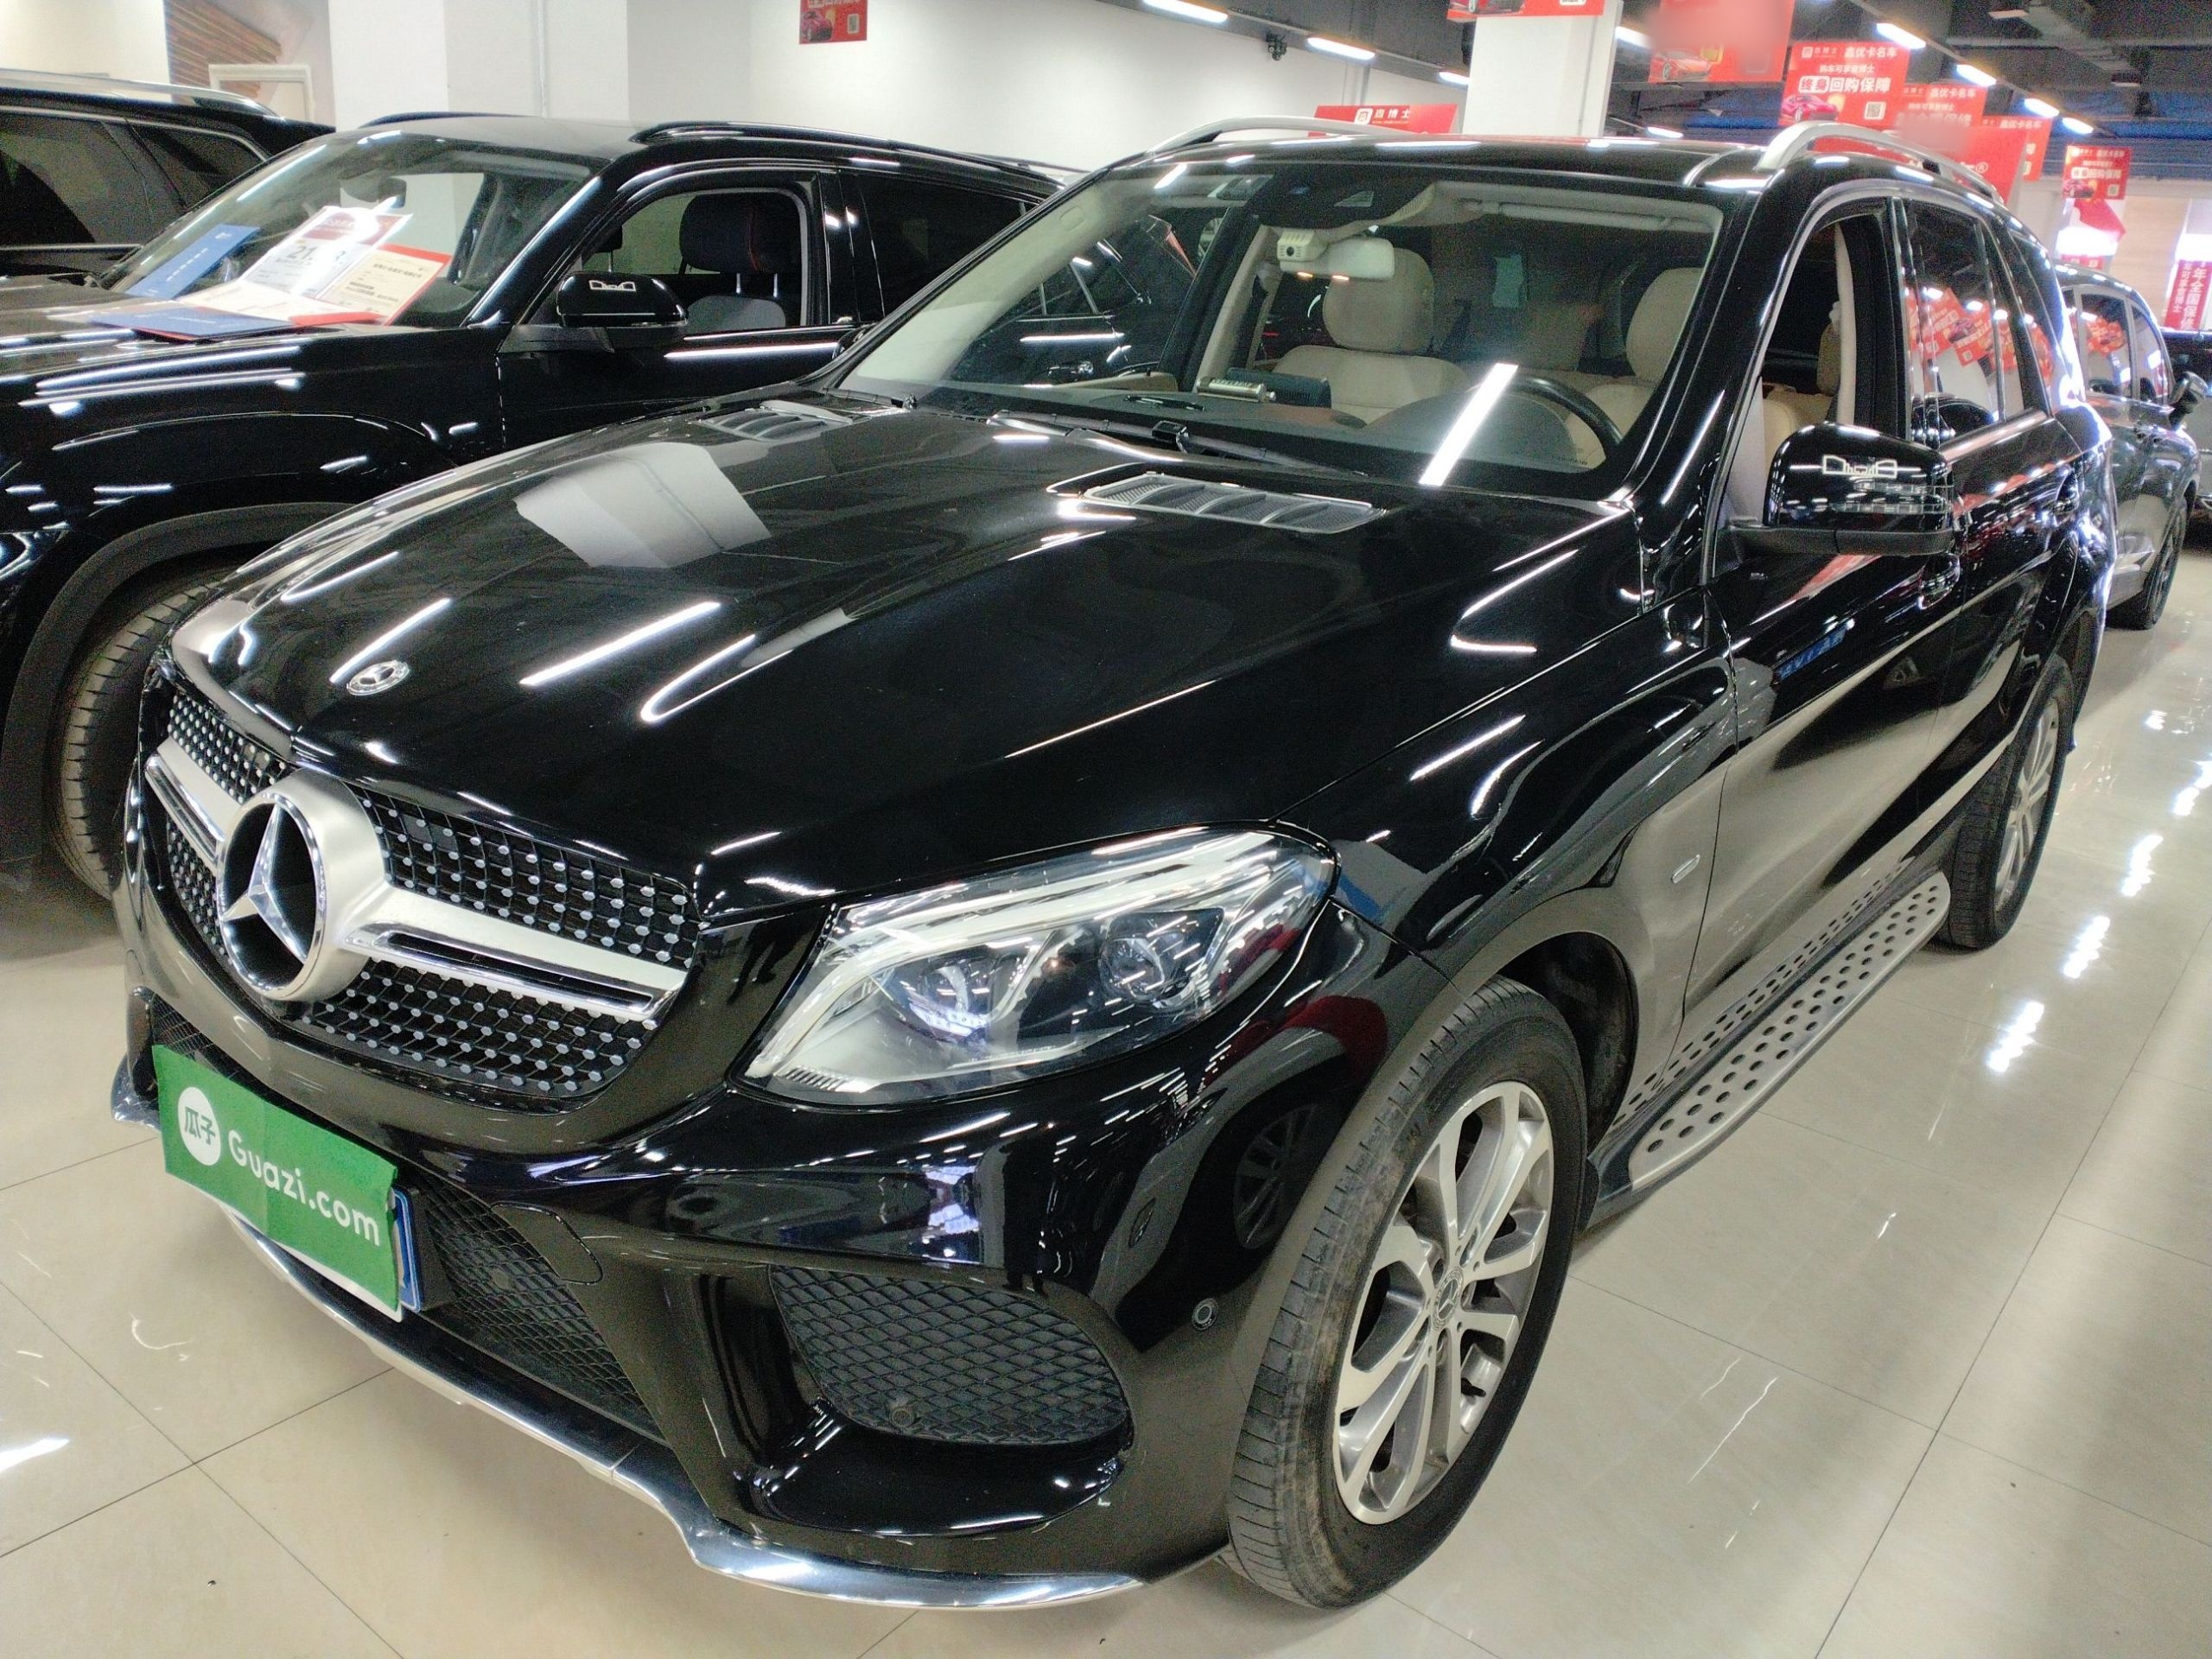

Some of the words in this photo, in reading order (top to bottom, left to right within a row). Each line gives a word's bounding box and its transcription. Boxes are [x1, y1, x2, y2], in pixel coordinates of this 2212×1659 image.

[1800, 76, 1891, 93] 终身回购保障
[183, 1105, 217, 1146] 瓜子
[226, 1129, 382, 1247] Guazi.com
